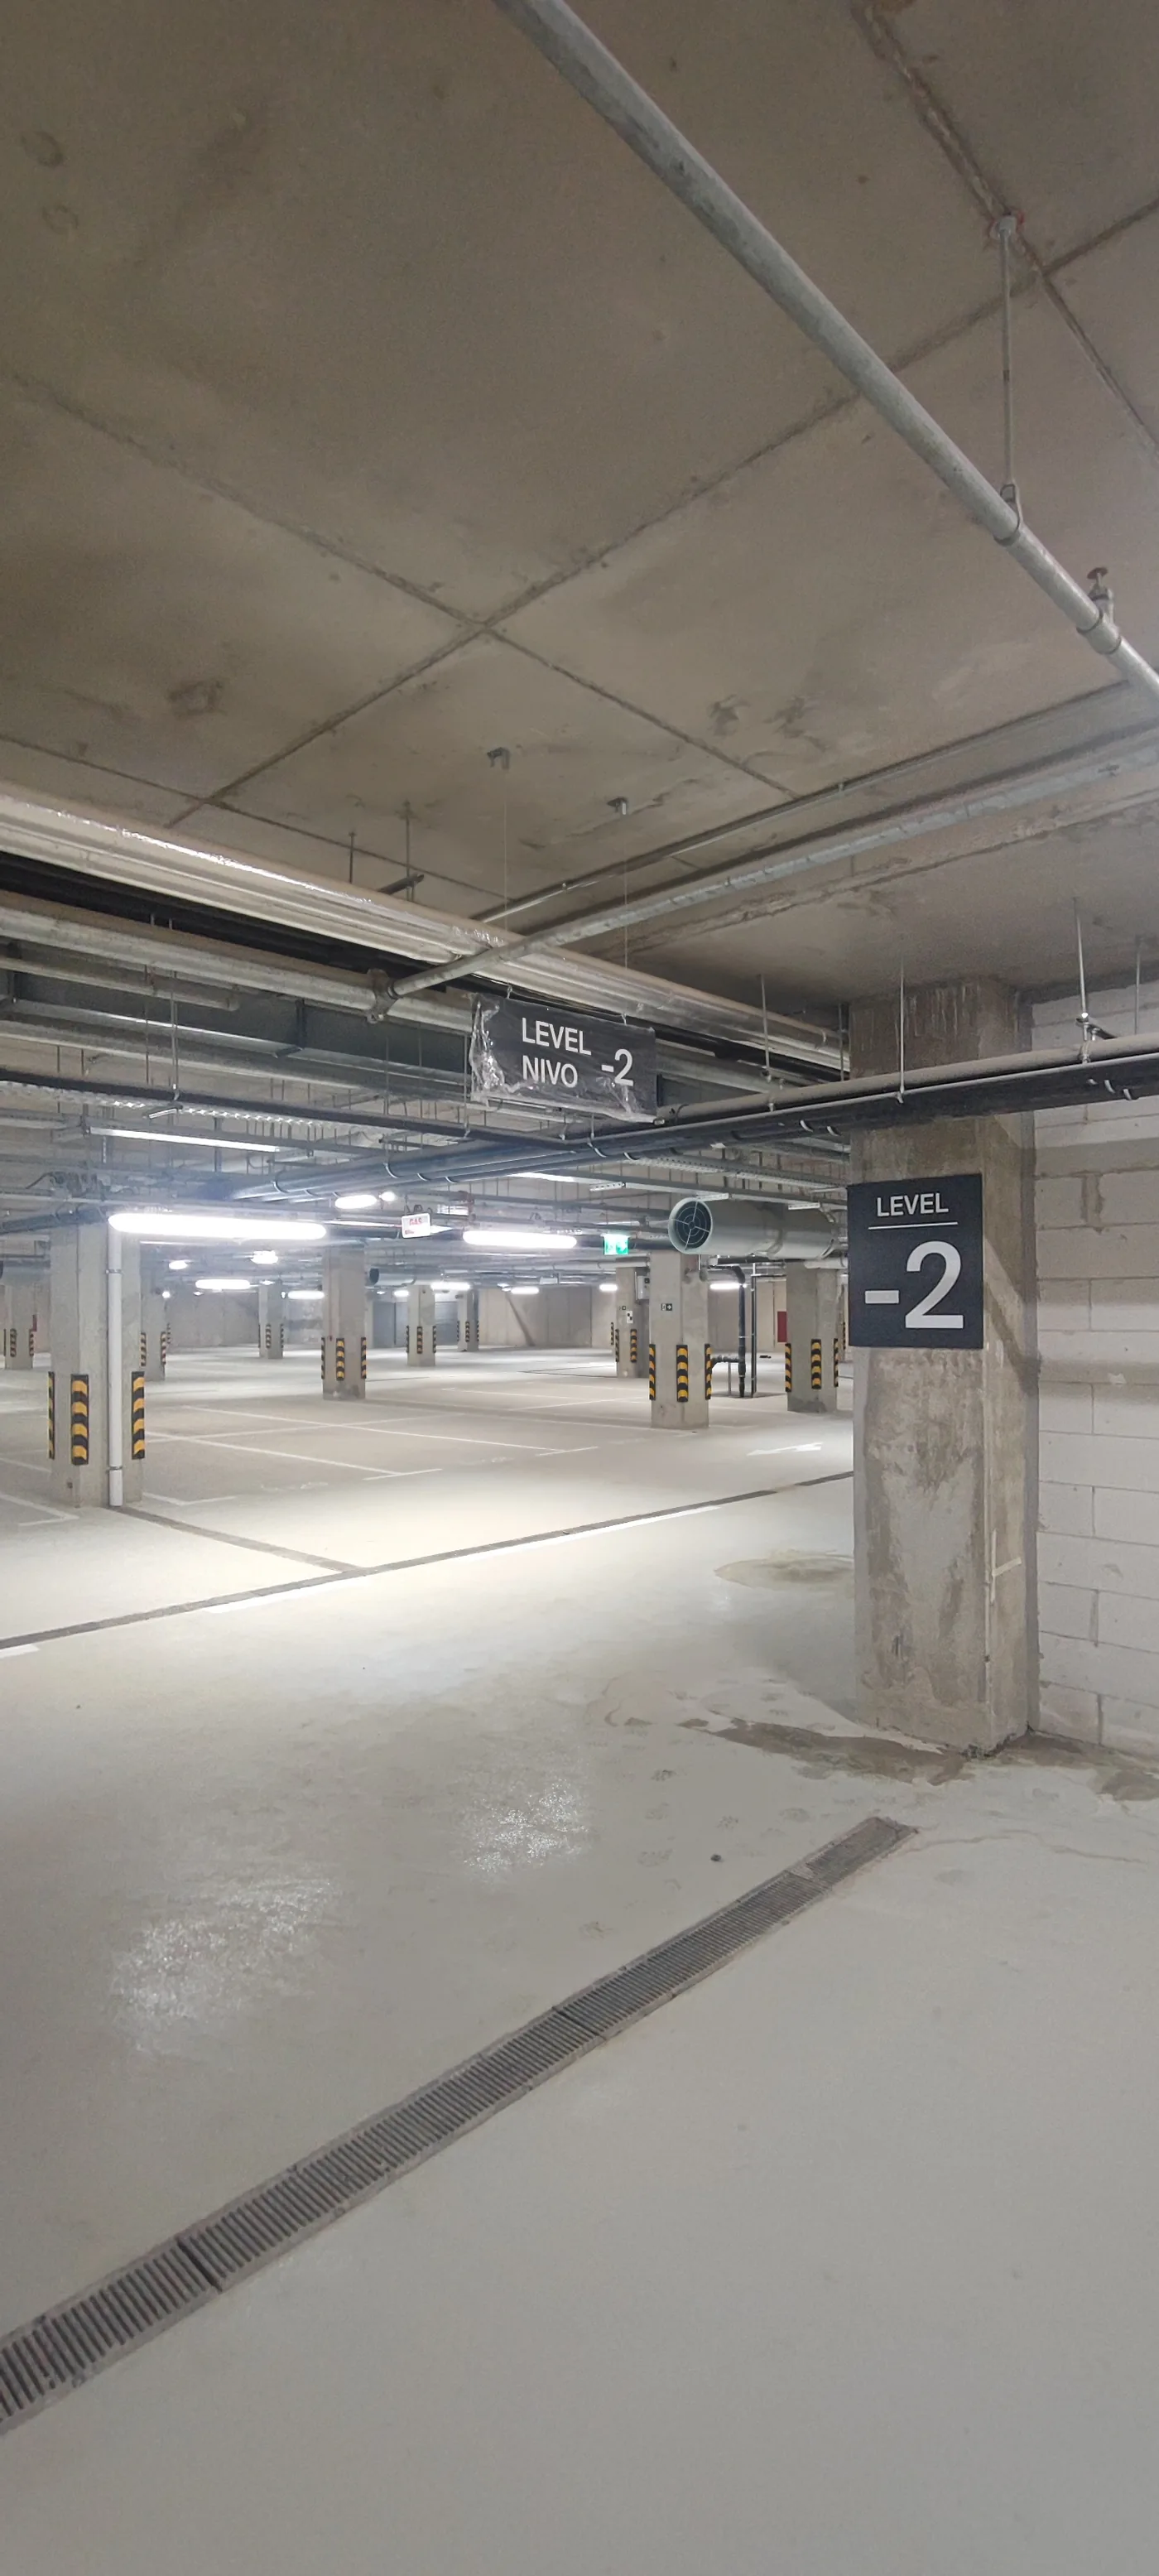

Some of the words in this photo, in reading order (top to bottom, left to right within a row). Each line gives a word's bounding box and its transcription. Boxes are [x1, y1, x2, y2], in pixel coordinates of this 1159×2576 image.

[522, 1017, 592, 1056] LEVEL
[522, 1055, 579, 1089] NIVO
[601, 1048, 634, 1087] -2
[876, 1192, 950, 1217] LEVEL
[864, 1240, 964, 1329] -2
